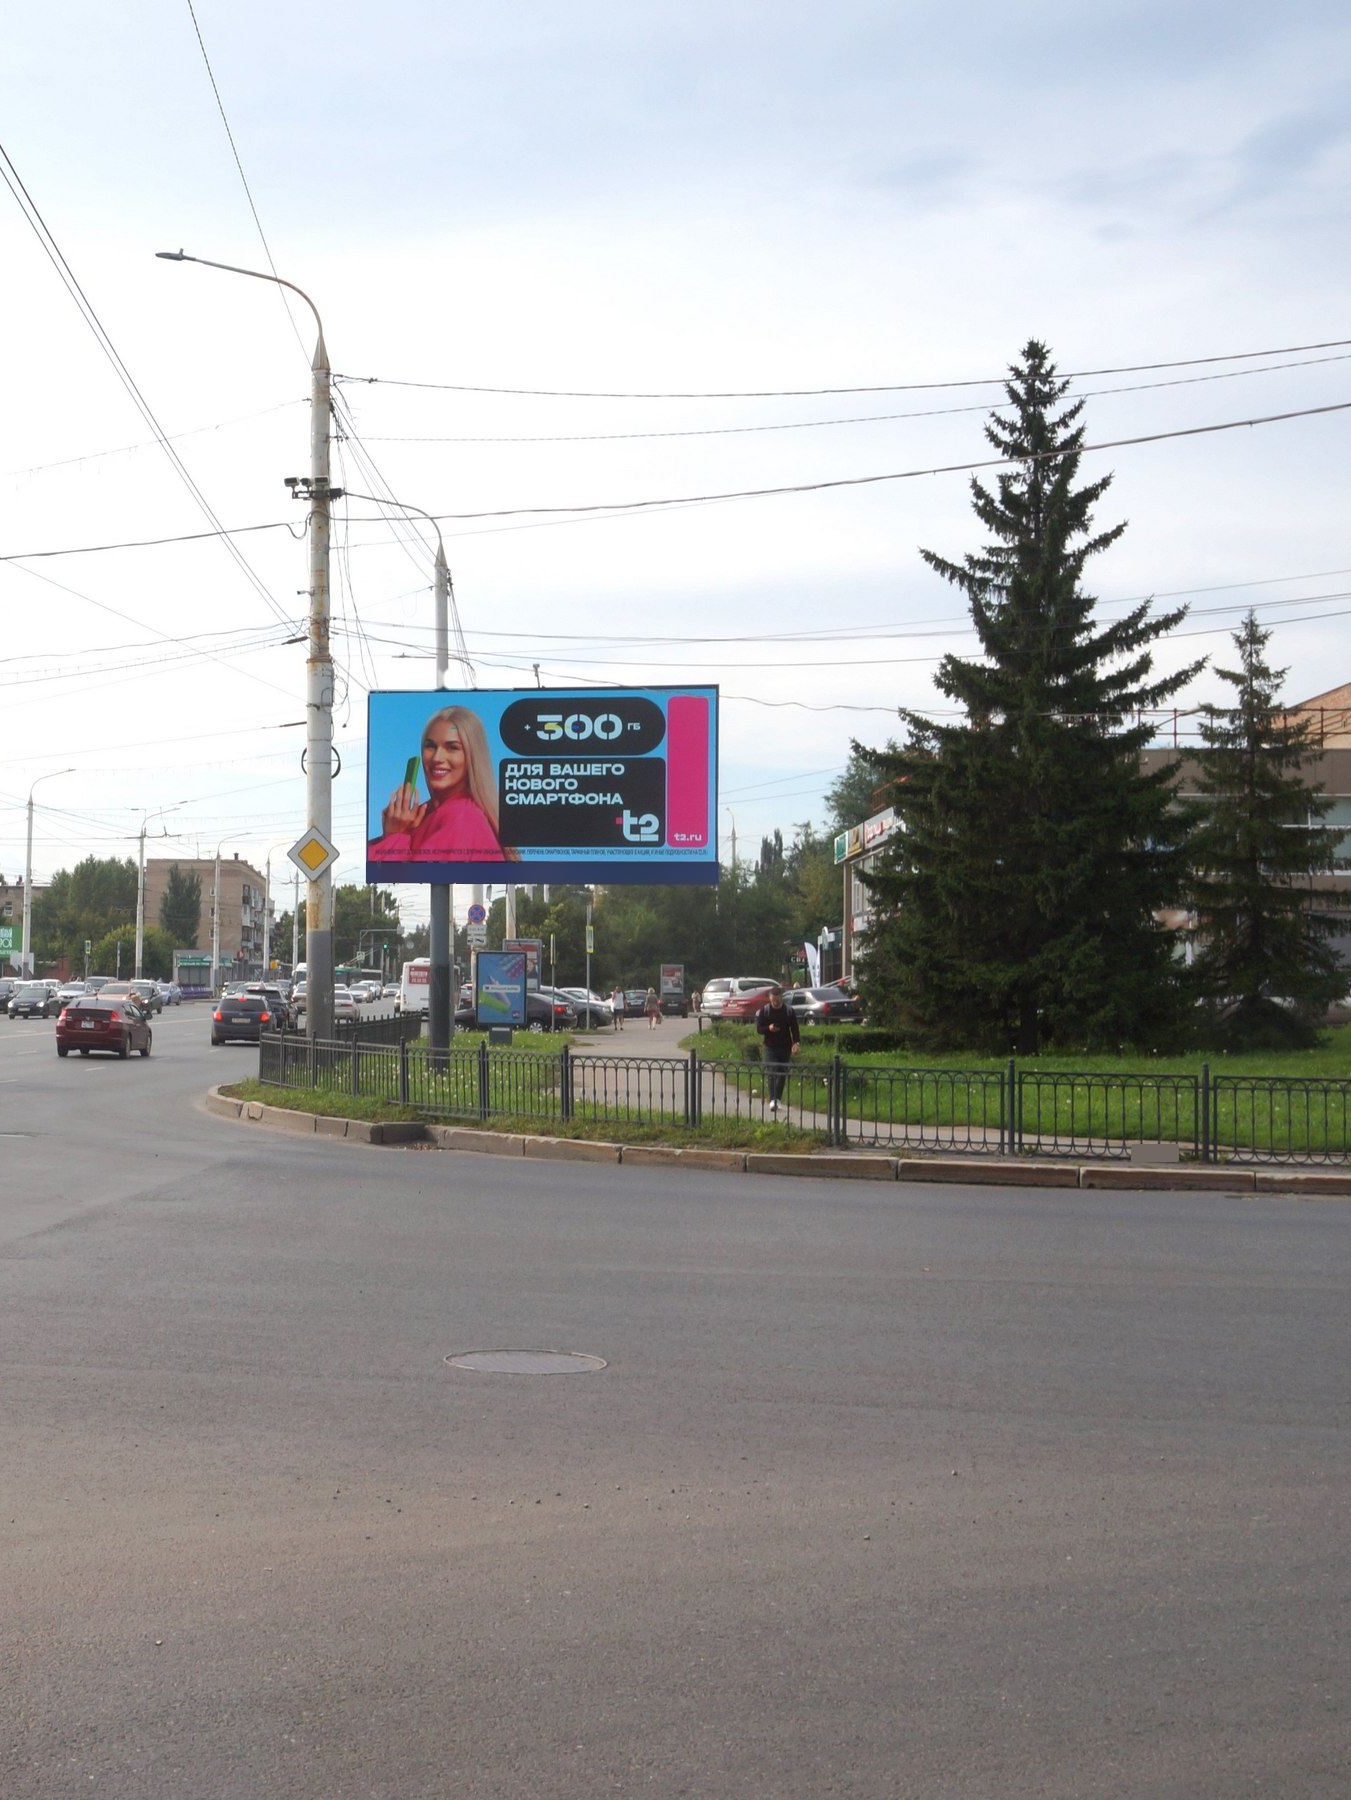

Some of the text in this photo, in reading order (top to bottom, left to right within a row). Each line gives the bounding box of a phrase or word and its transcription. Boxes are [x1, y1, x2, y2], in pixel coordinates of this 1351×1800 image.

[536, 714, 623, 740] 300
[627, 722, 641, 731] ГБ
[505, 763, 625, 778] ДЛЯ ВАШЕГО
[505, 778, 578, 790] НОВОГО
[505, 793, 624, 805] СМАРТФОНА
[622, 809, 660, 842] t2
[673, 833, 702, 842] t2.ru
